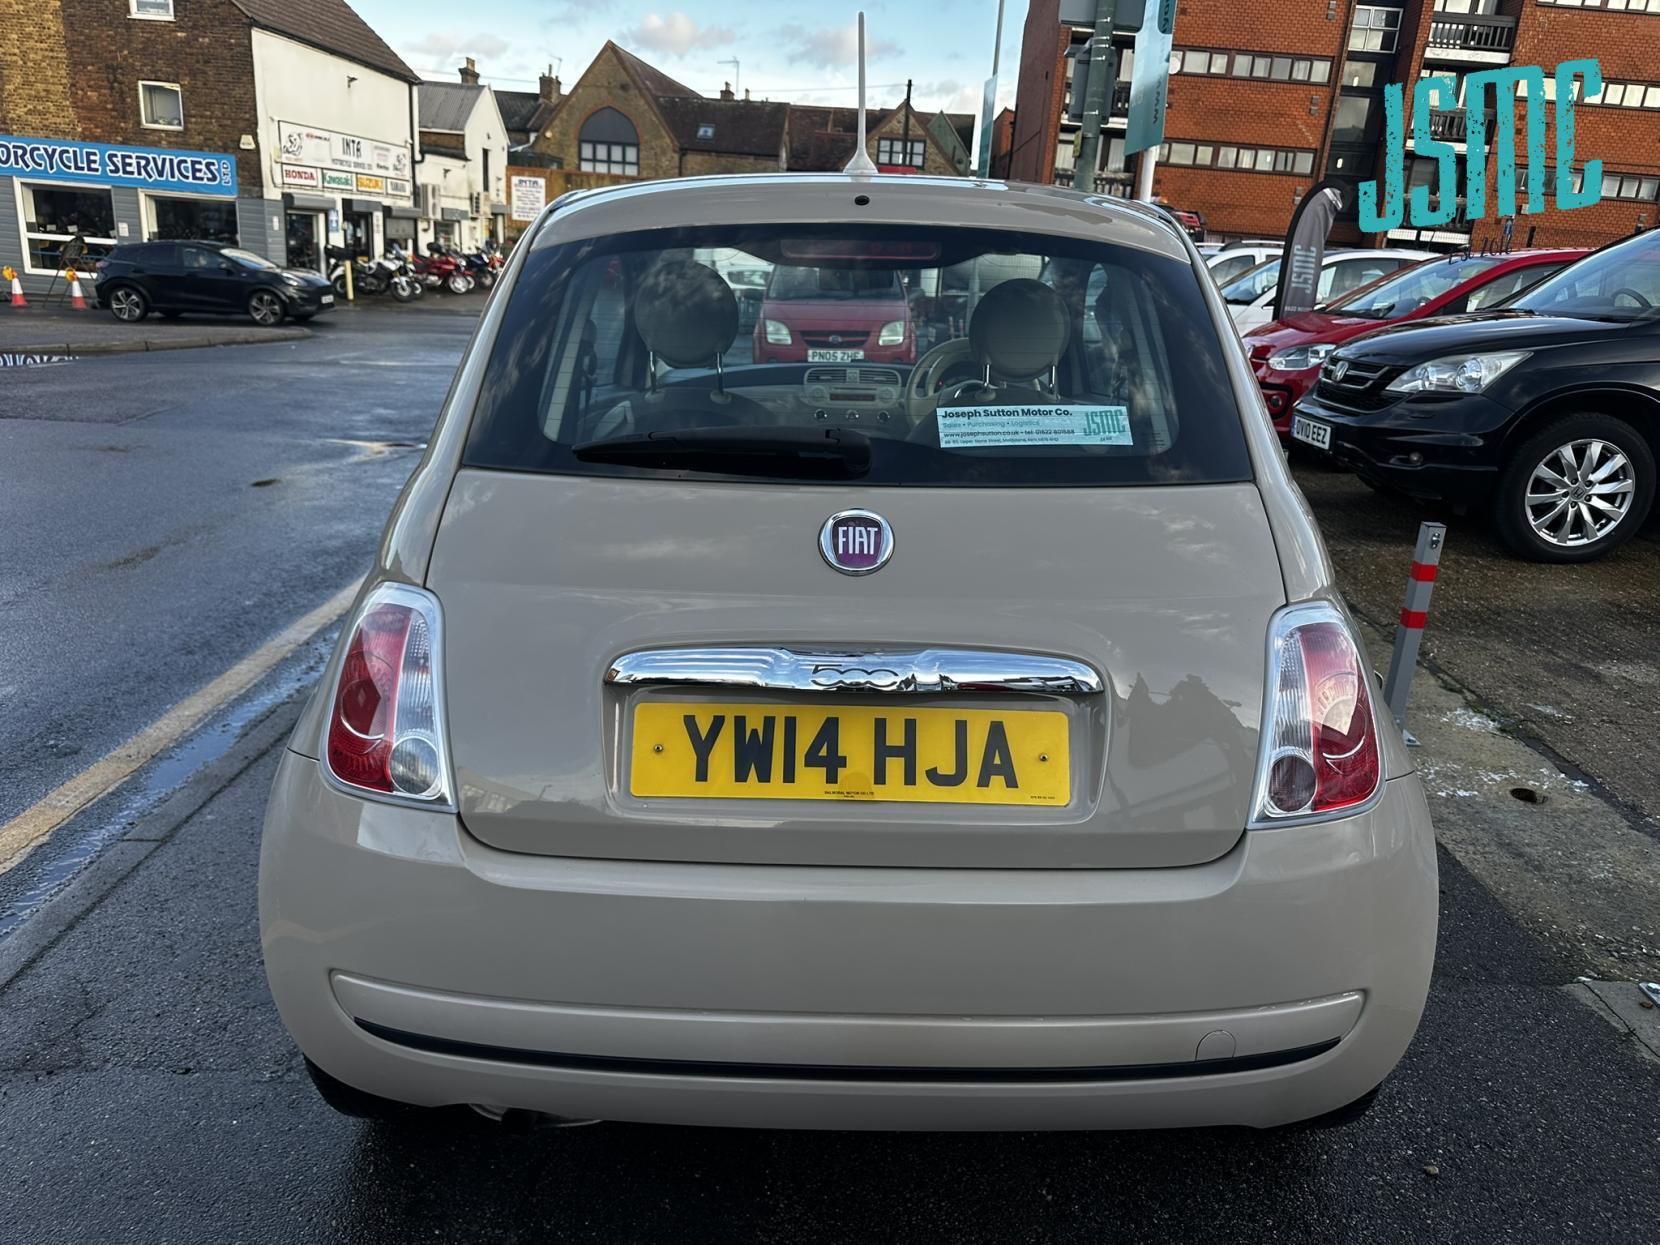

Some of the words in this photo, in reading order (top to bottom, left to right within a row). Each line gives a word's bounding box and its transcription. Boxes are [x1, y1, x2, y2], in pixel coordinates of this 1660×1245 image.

[106, 151, 220, 184] SERVICES
[221, 160, 231, 185] LTD
[285, 169, 316, 181] HONDA
[942, 409, 981, 420] Joseph
[983, 408, 1020, 417] Sutton
[1021, 408, 1053, 417] Motor
[1055, 408, 1073, 417] Co.
[1083, 409, 1126, 436] JSMC
[1311, 425, 1327, 445] EEZ
[838, 526, 878, 555] FIAT
[811, 664, 900, 688] 500
[683, 714, 847, 784] YW14
[874, 718, 1019, 789] HJA
